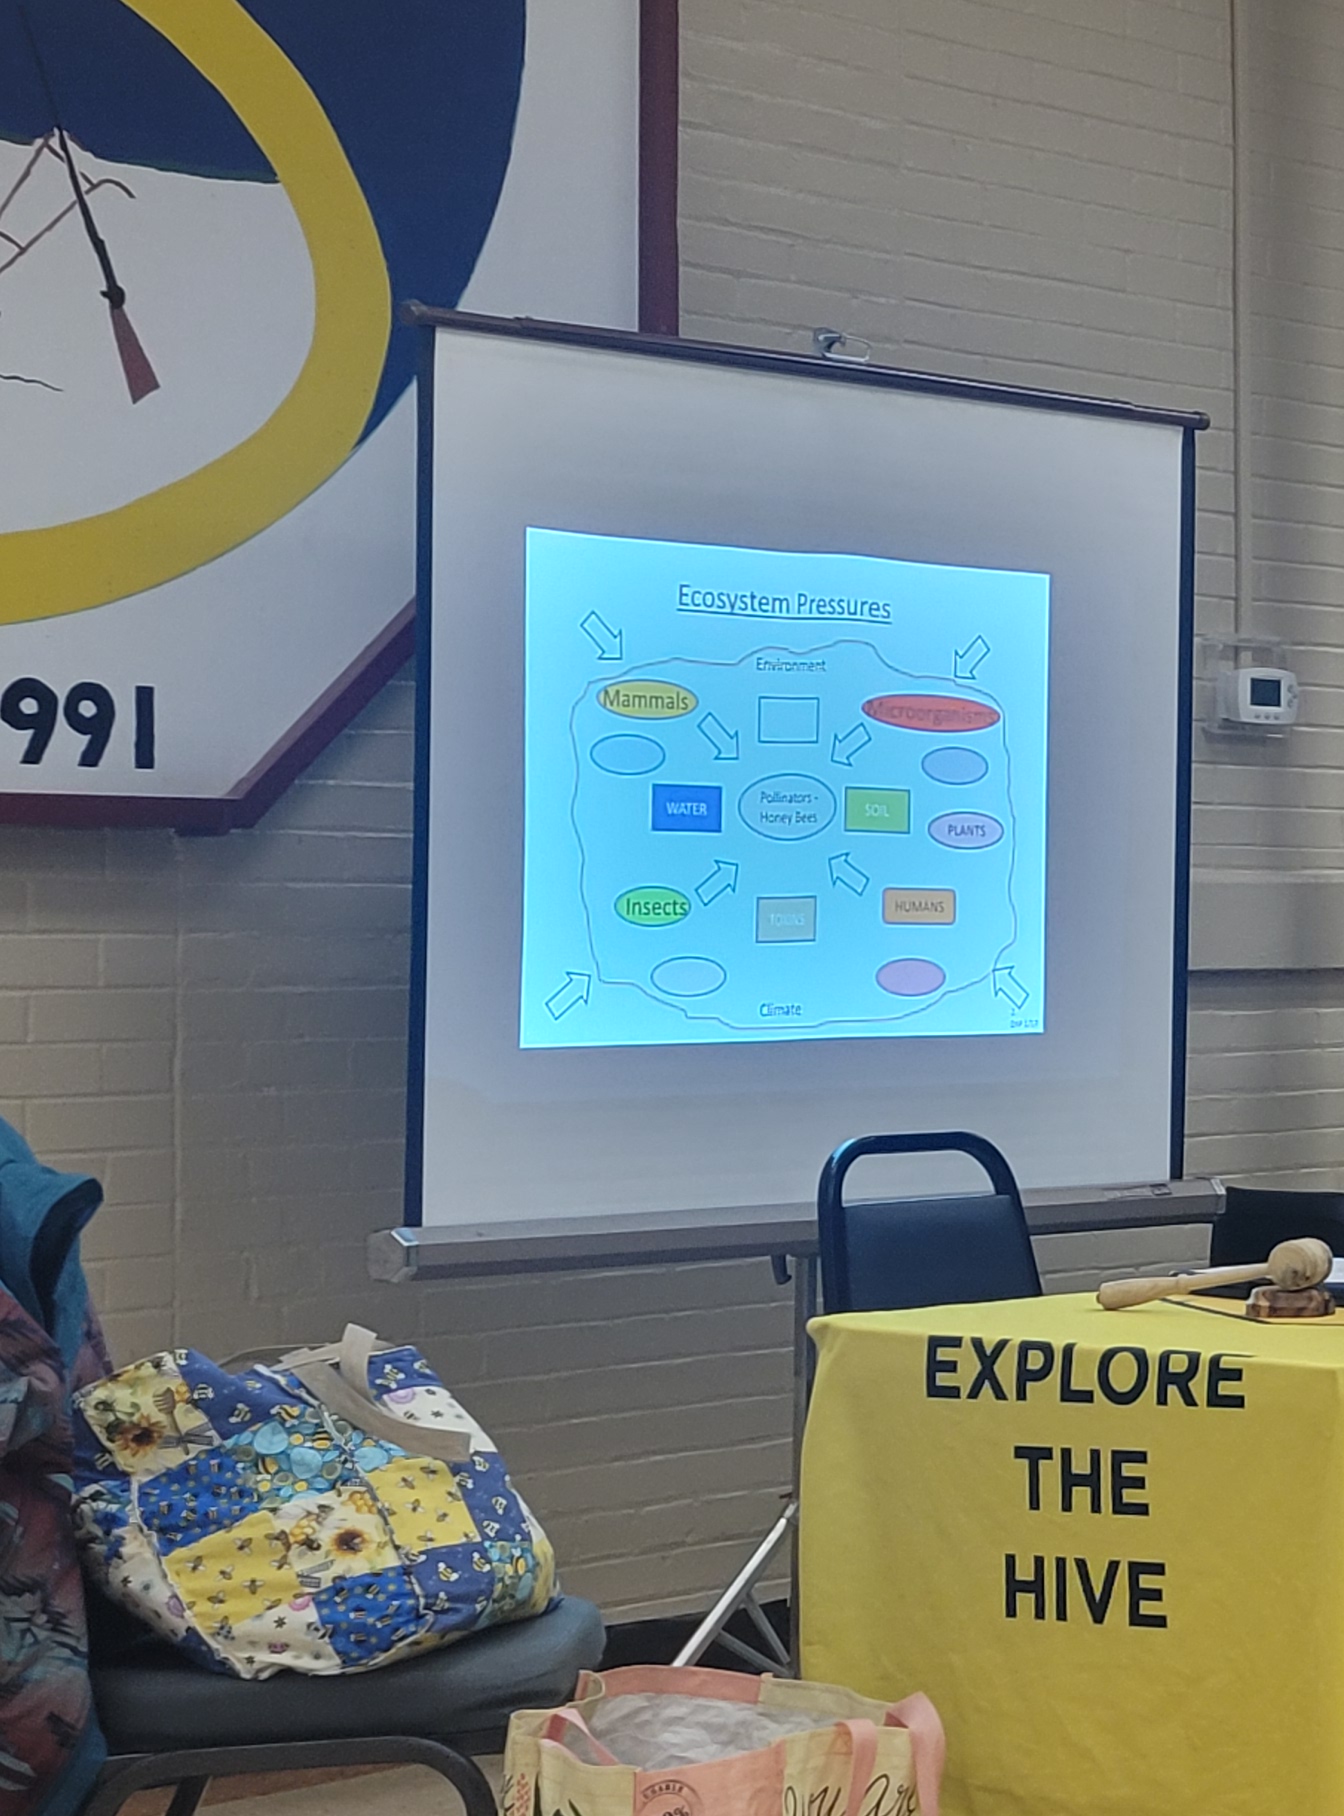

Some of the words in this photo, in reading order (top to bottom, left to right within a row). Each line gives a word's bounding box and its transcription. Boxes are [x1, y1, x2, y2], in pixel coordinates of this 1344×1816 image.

[678, 584, 790, 614] Ecosystem
[797, 593, 891, 619] Pressures
[756, 657, 827, 672] Environment
[603, 688, 689, 711] Mammals
[760, 791, 812, 804] Pollinators
[666, 801, 707, 816] WATER
[865, 803, 890, 817] SOIL
[760, 811, 793, 826] Honey
[795, 811, 817, 823] Bees
[948, 824, 987, 837] PLANTS
[626, 898, 689, 916] Insects
[894, 899, 945, 914] HUMANS
[759, 1002, 802, 1017] Climate
[925, 1335, 1256, 1409] EXPLORE
[1013, 1445, 1150, 1517] THE
[1004, 1553, 1169, 1629] HIVE
